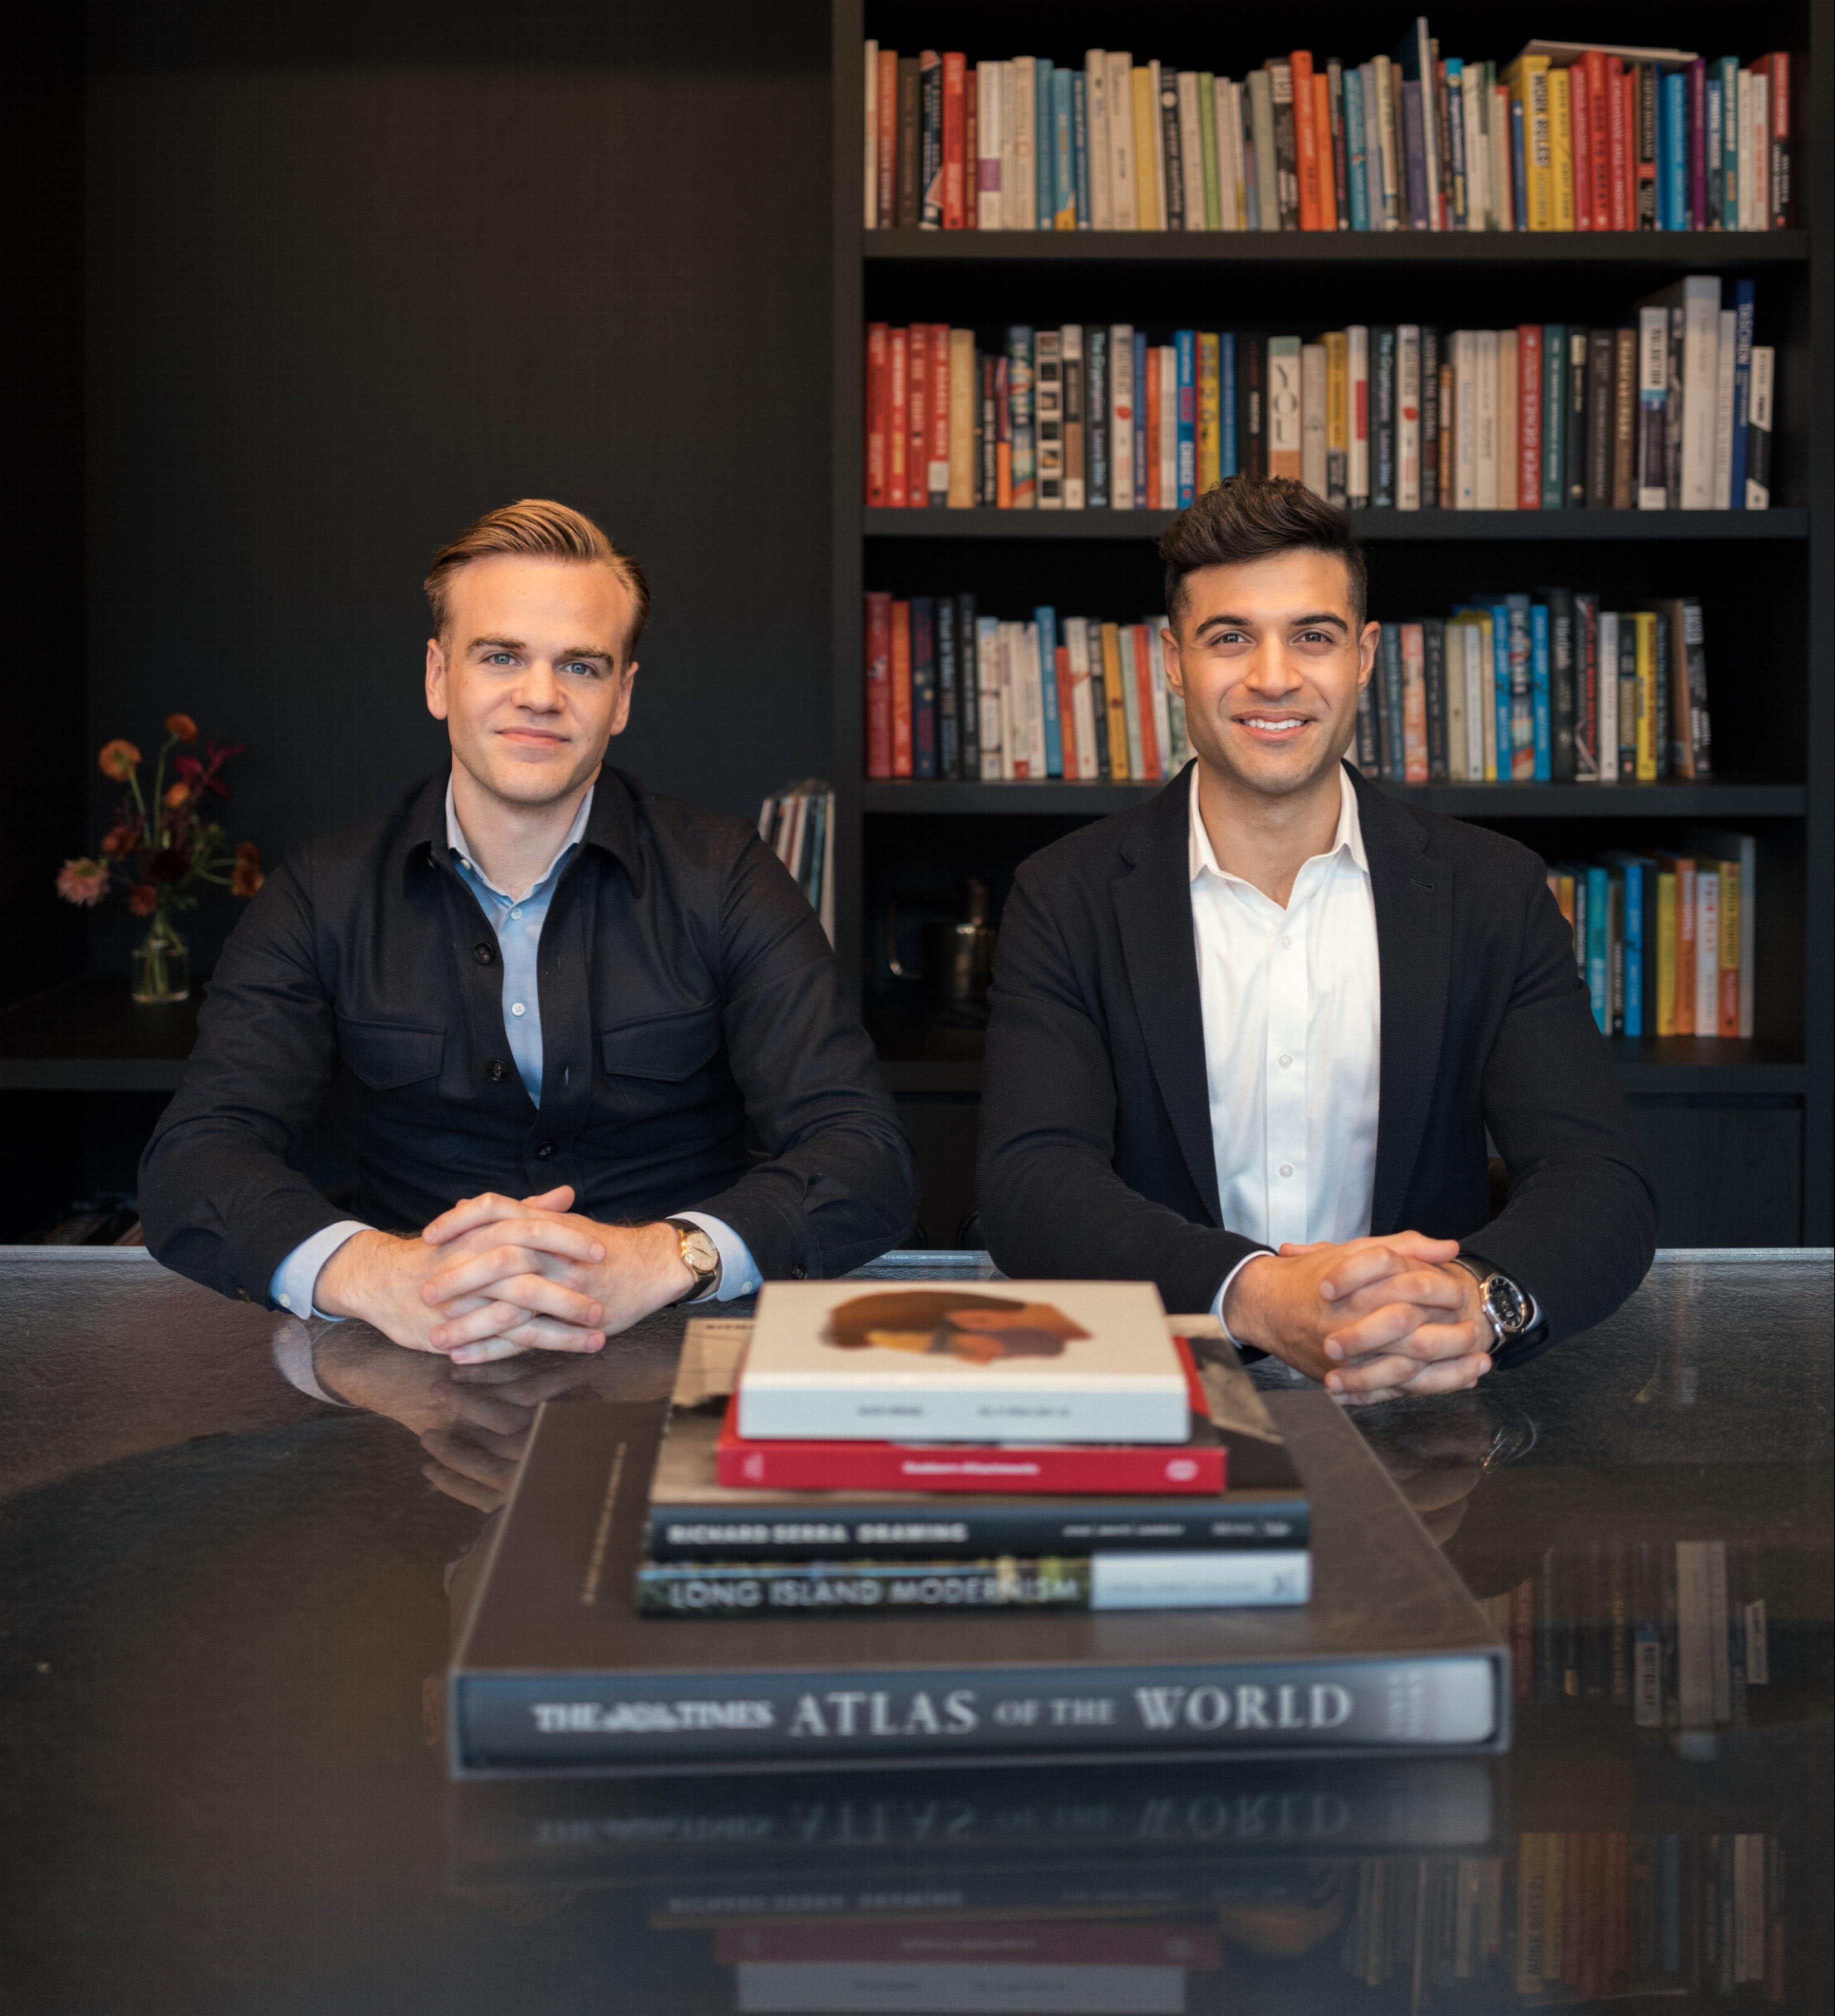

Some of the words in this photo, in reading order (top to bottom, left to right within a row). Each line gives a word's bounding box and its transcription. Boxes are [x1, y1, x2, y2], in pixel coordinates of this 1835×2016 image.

[1533, 75, 1548, 116] WORK
[1534, 118, 1550, 168] RULES!
[1091, 332, 1105, 354] The
[1378, 332, 1392, 354] The
[668, 1523, 769, 1544] RICHARD
[772, 1523, 848, 1543] SERRA
[856, 1522, 969, 1542] DRAWING
[668, 1580, 764, 1609] LONG
[769, 1578, 882, 1606] ISLAND
[888, 1576, 1080, 1604] MODERNISM
[532, 1702, 600, 1732] THE
[676, 1700, 774, 1730] TIMES
[790, 1691, 976, 1737] ATLAS
[996, 1700, 1040, 1728] OF
[1050, 1698, 1114, 1726] THE
[1134, 1682, 1353, 1733] WORLD
